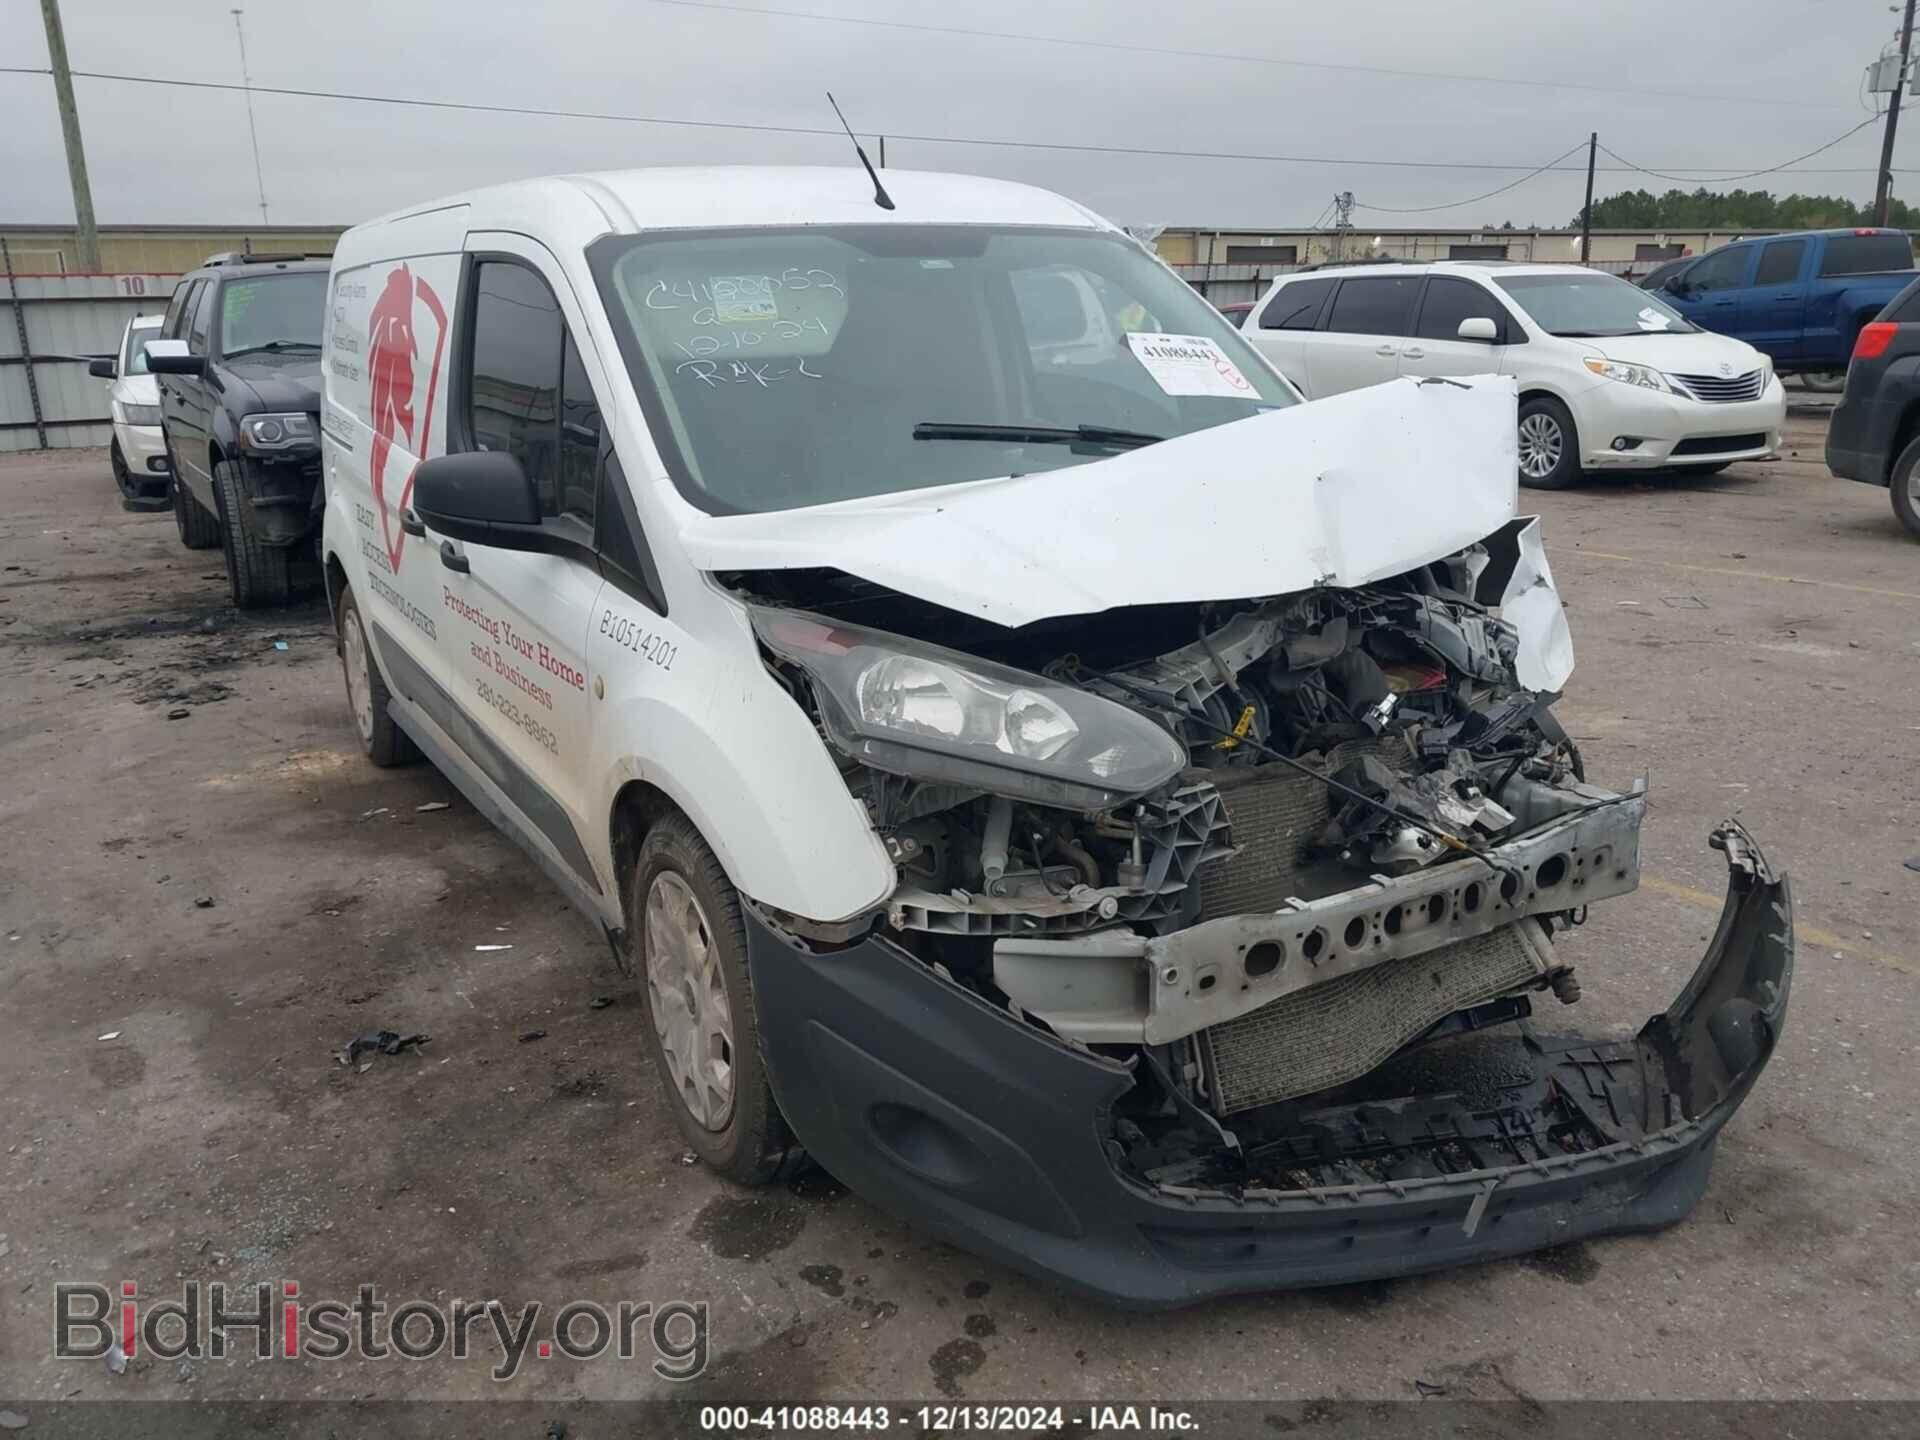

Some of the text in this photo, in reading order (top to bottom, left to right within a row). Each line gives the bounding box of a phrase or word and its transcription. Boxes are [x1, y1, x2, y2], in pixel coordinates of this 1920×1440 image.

[121, 276, 145, 296] 10
[368, 570, 437, 641] TECHNOLOGIES
[443, 585, 585, 691] Protecting Your Home
[600, 609, 678, 671] B10514201
[470, 641, 553, 711] and Business
